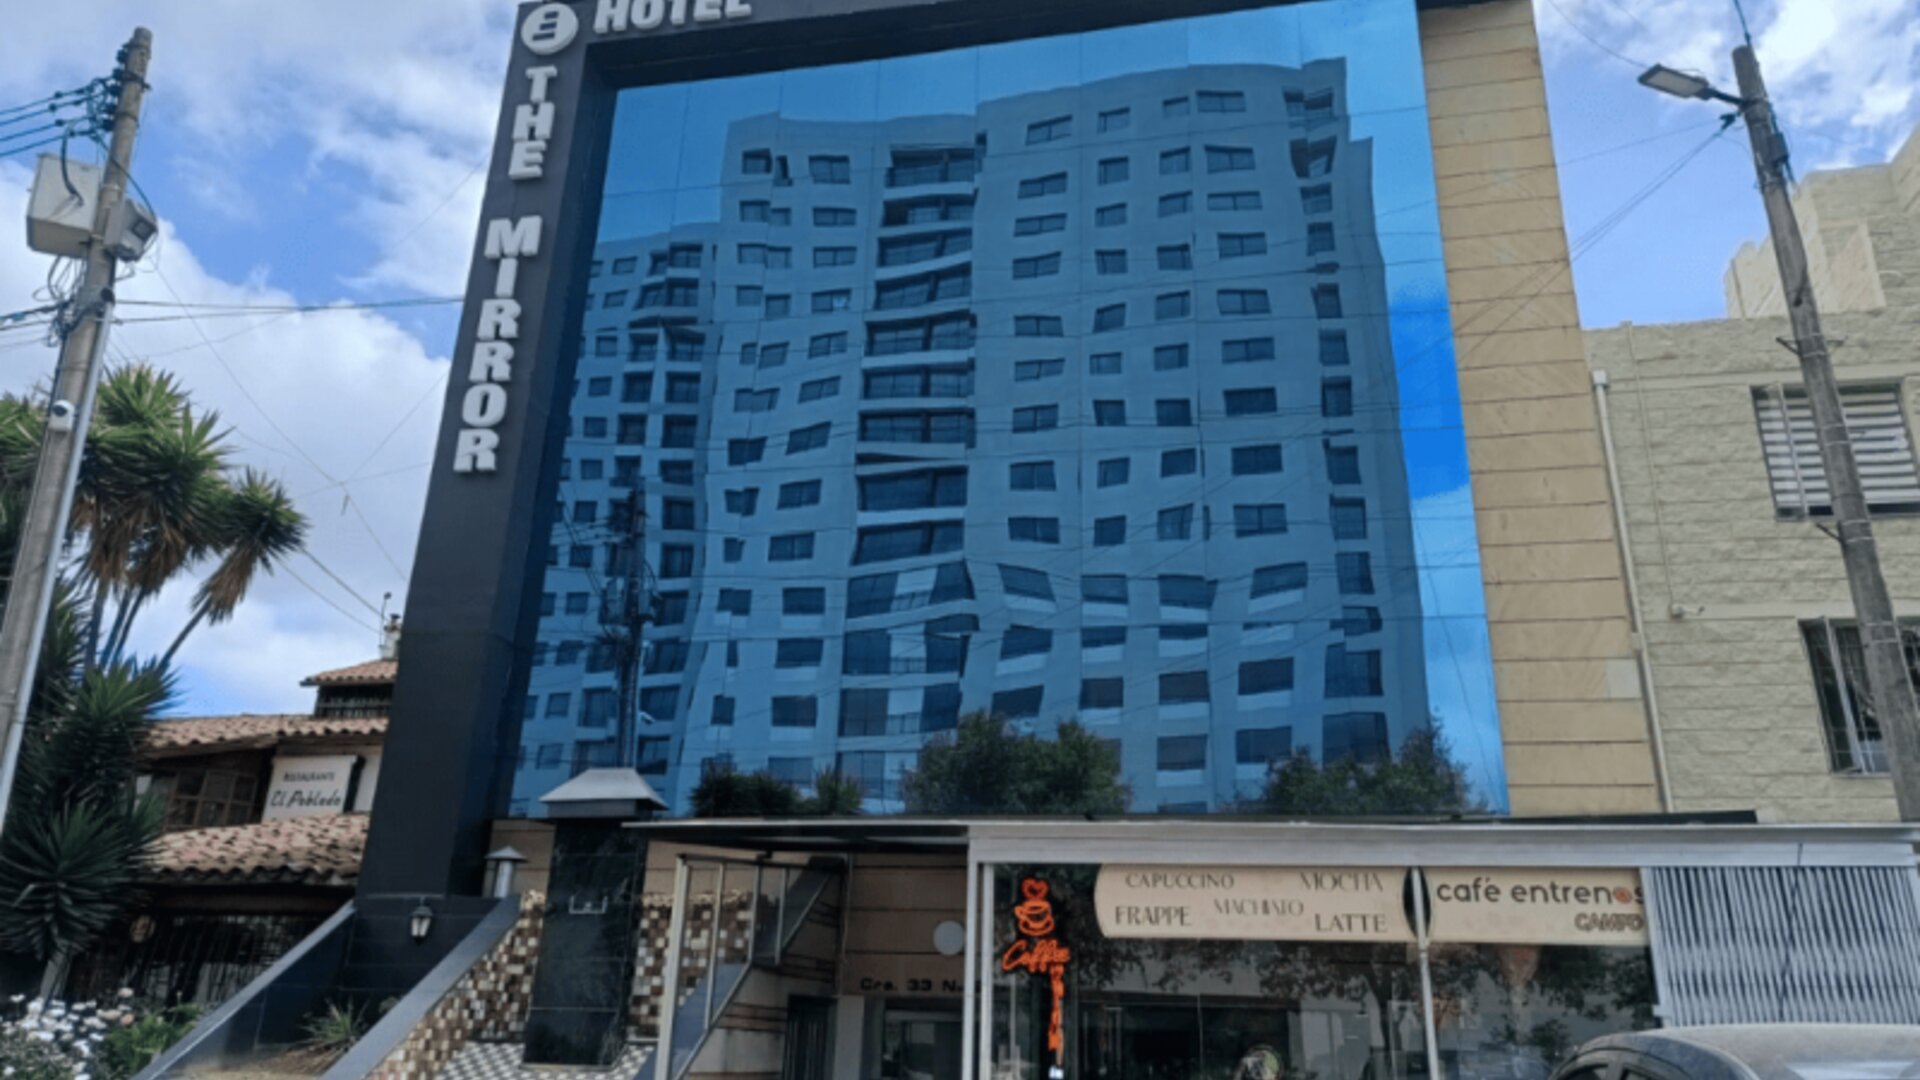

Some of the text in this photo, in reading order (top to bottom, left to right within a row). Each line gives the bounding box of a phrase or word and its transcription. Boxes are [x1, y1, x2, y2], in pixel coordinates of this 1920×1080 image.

[591, 0, 752, 34] HOTEL
[453, 65, 557, 473] THE MIRROR
[1125, 872, 1235, 889] CAPUCCINO
[1301, 871, 1383, 892] MOCHA
[1436, 877, 1501, 902] café
[1115, 905, 1191, 927] FRAPPE
[1315, 913, 1388, 933] LATTE
[907, 978, 932, 992] 33
